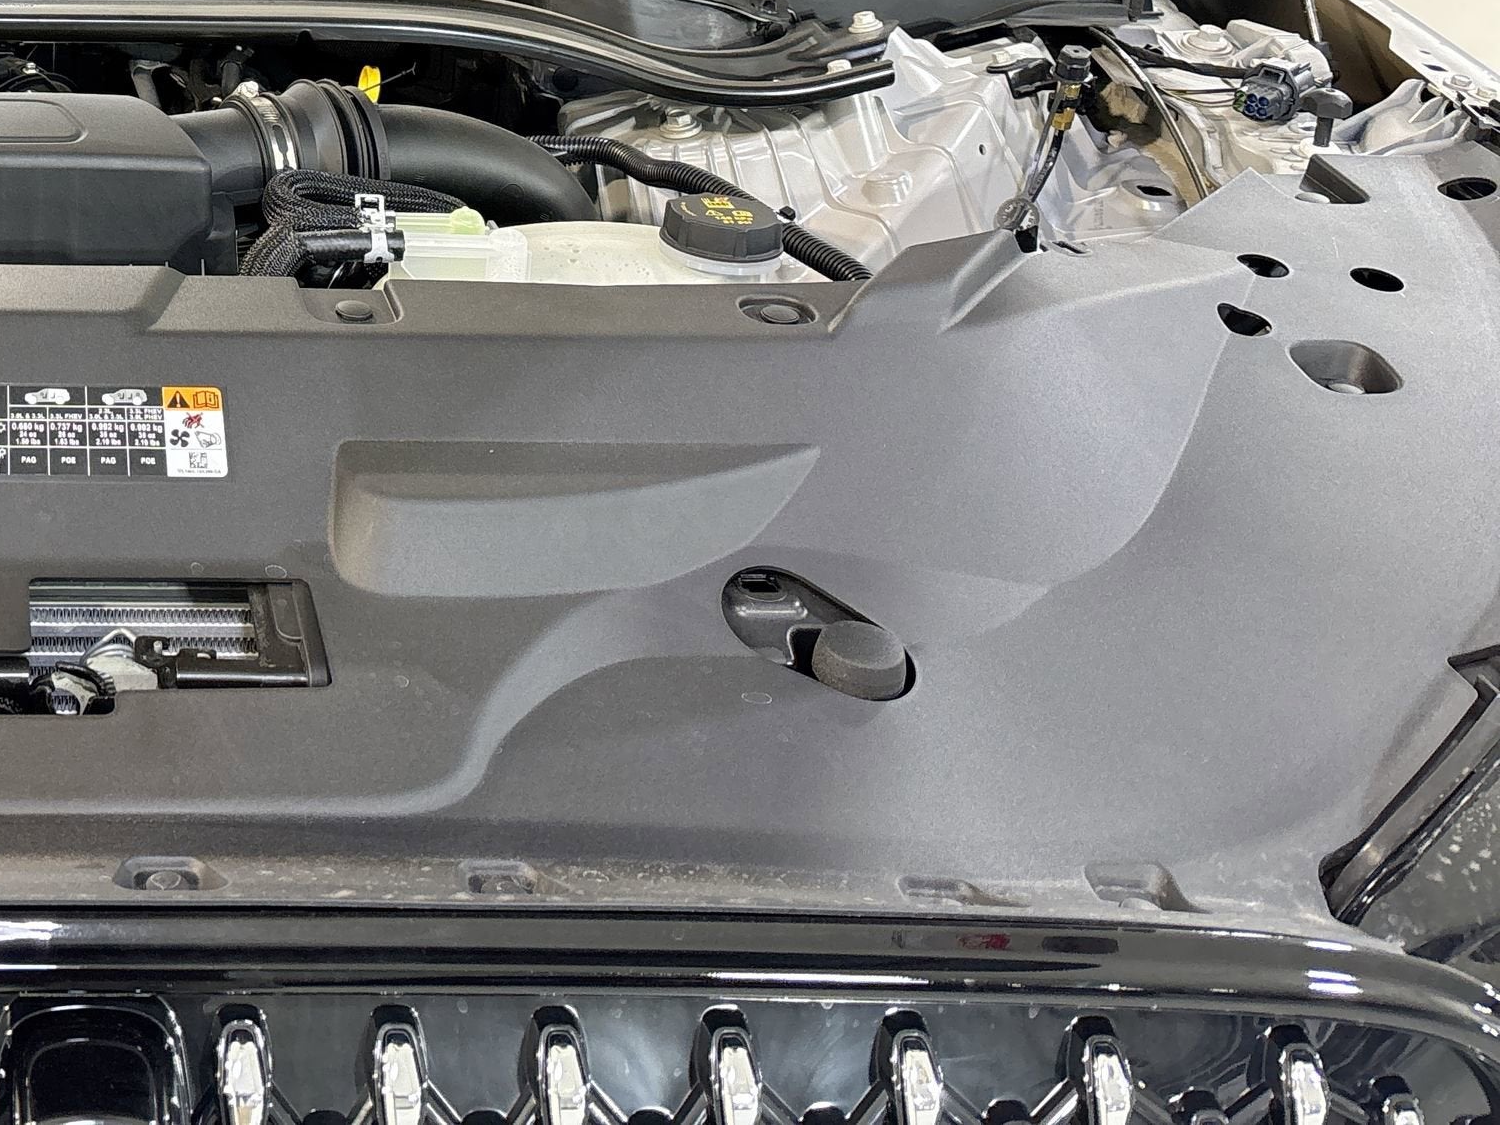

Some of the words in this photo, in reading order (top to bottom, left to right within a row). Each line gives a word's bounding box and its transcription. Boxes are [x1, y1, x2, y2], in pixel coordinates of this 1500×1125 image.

[34, 422, 45, 433] kg
[50, 422, 71, 431] 0.737
[72, 422, 83, 433] kg
[113, 423, 125, 433] kg
[152, 423, 163, 434] kg
[69, 438, 80, 446] lbs
[110, 438, 122, 446] lbs
[149, 438, 161, 446] lbs
[20, 456, 37, 464] PAG
[60, 456, 76, 464] POE
[100, 456, 117, 465] PAG
[140, 457, 156, 465] POE
